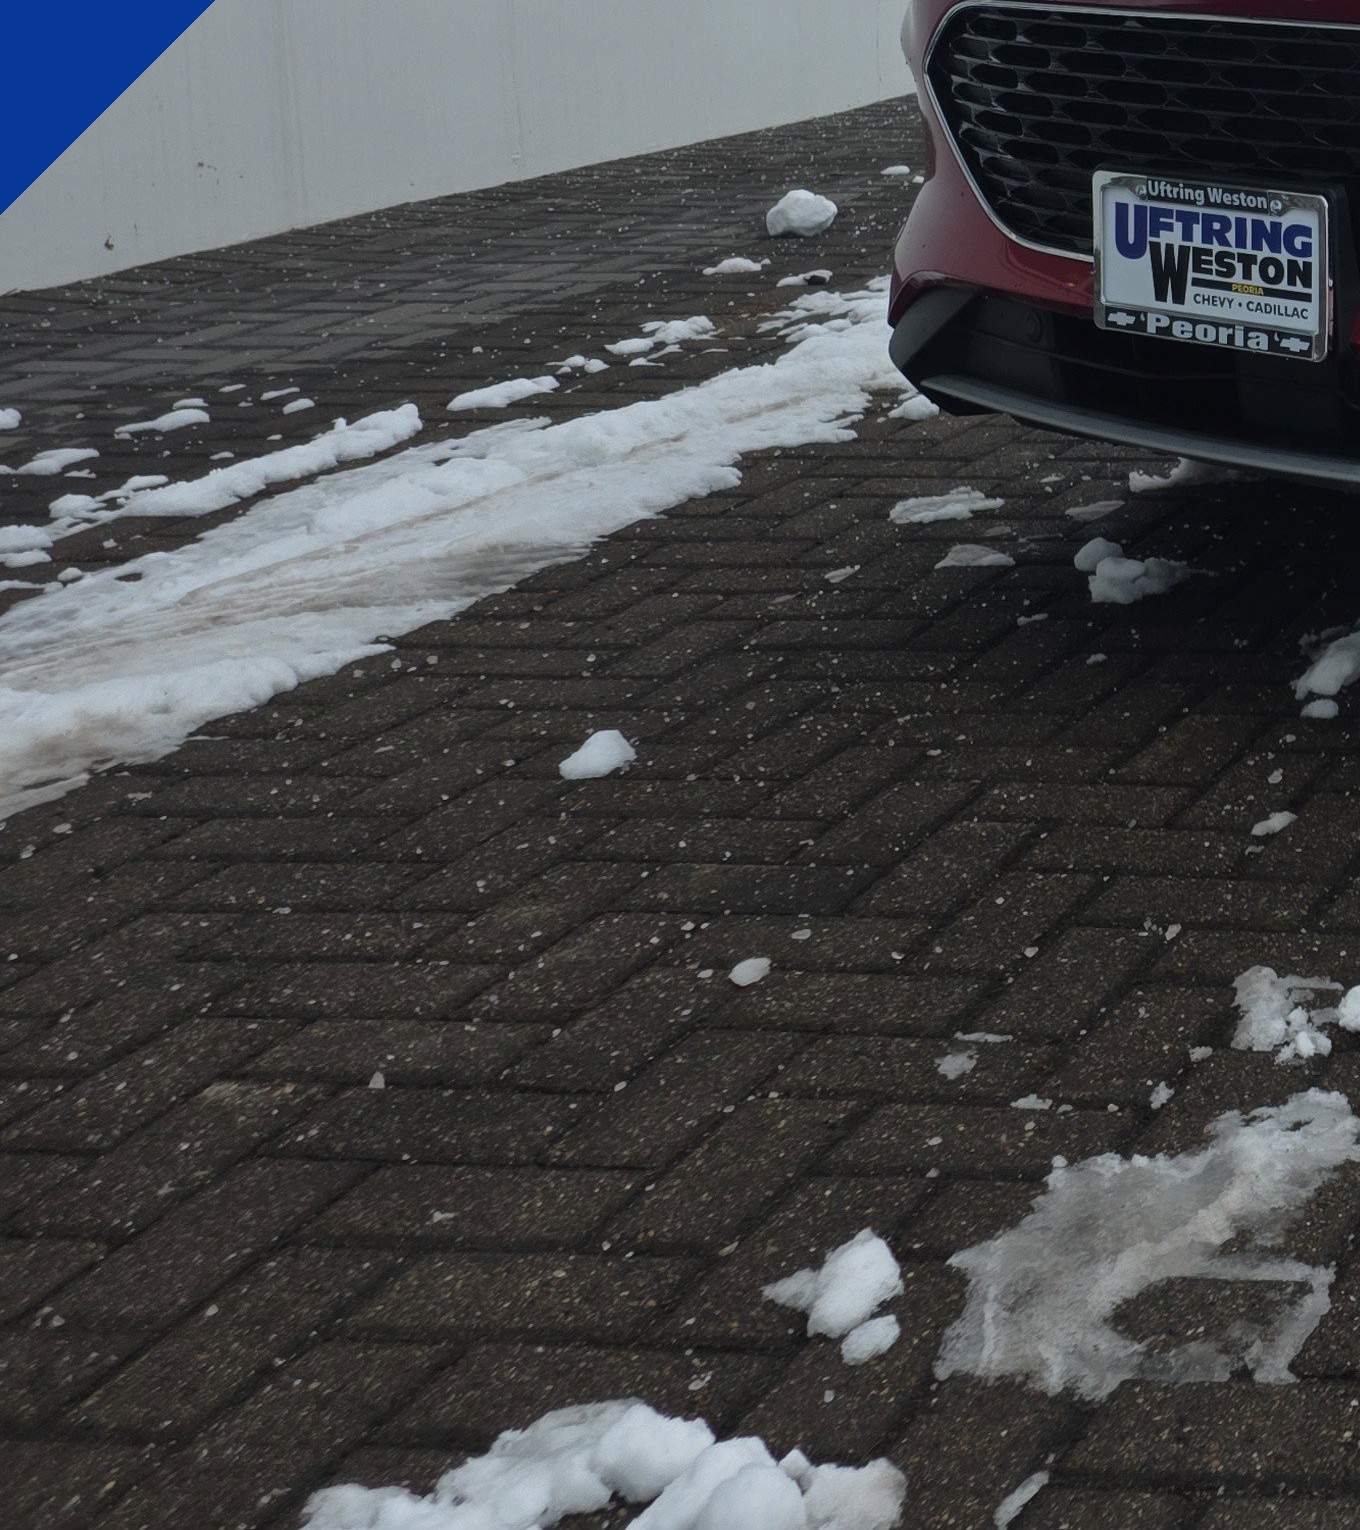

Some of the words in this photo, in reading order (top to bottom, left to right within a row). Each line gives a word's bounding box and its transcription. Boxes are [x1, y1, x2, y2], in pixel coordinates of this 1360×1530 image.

[1147, 179, 1206, 205] Uftring
[1207, 186, 1268, 210] Weston
[1114, 201, 1313, 260] UFTRING
[1149, 240, 1313, 306] WESTON
[1231, 282, 1265, 297] PEORIA
[1193, 292, 1235, 310] CHEVY
[1246, 300, 1309, 320] CADILLAC
[1145, 311, 1270, 351] Peoria
